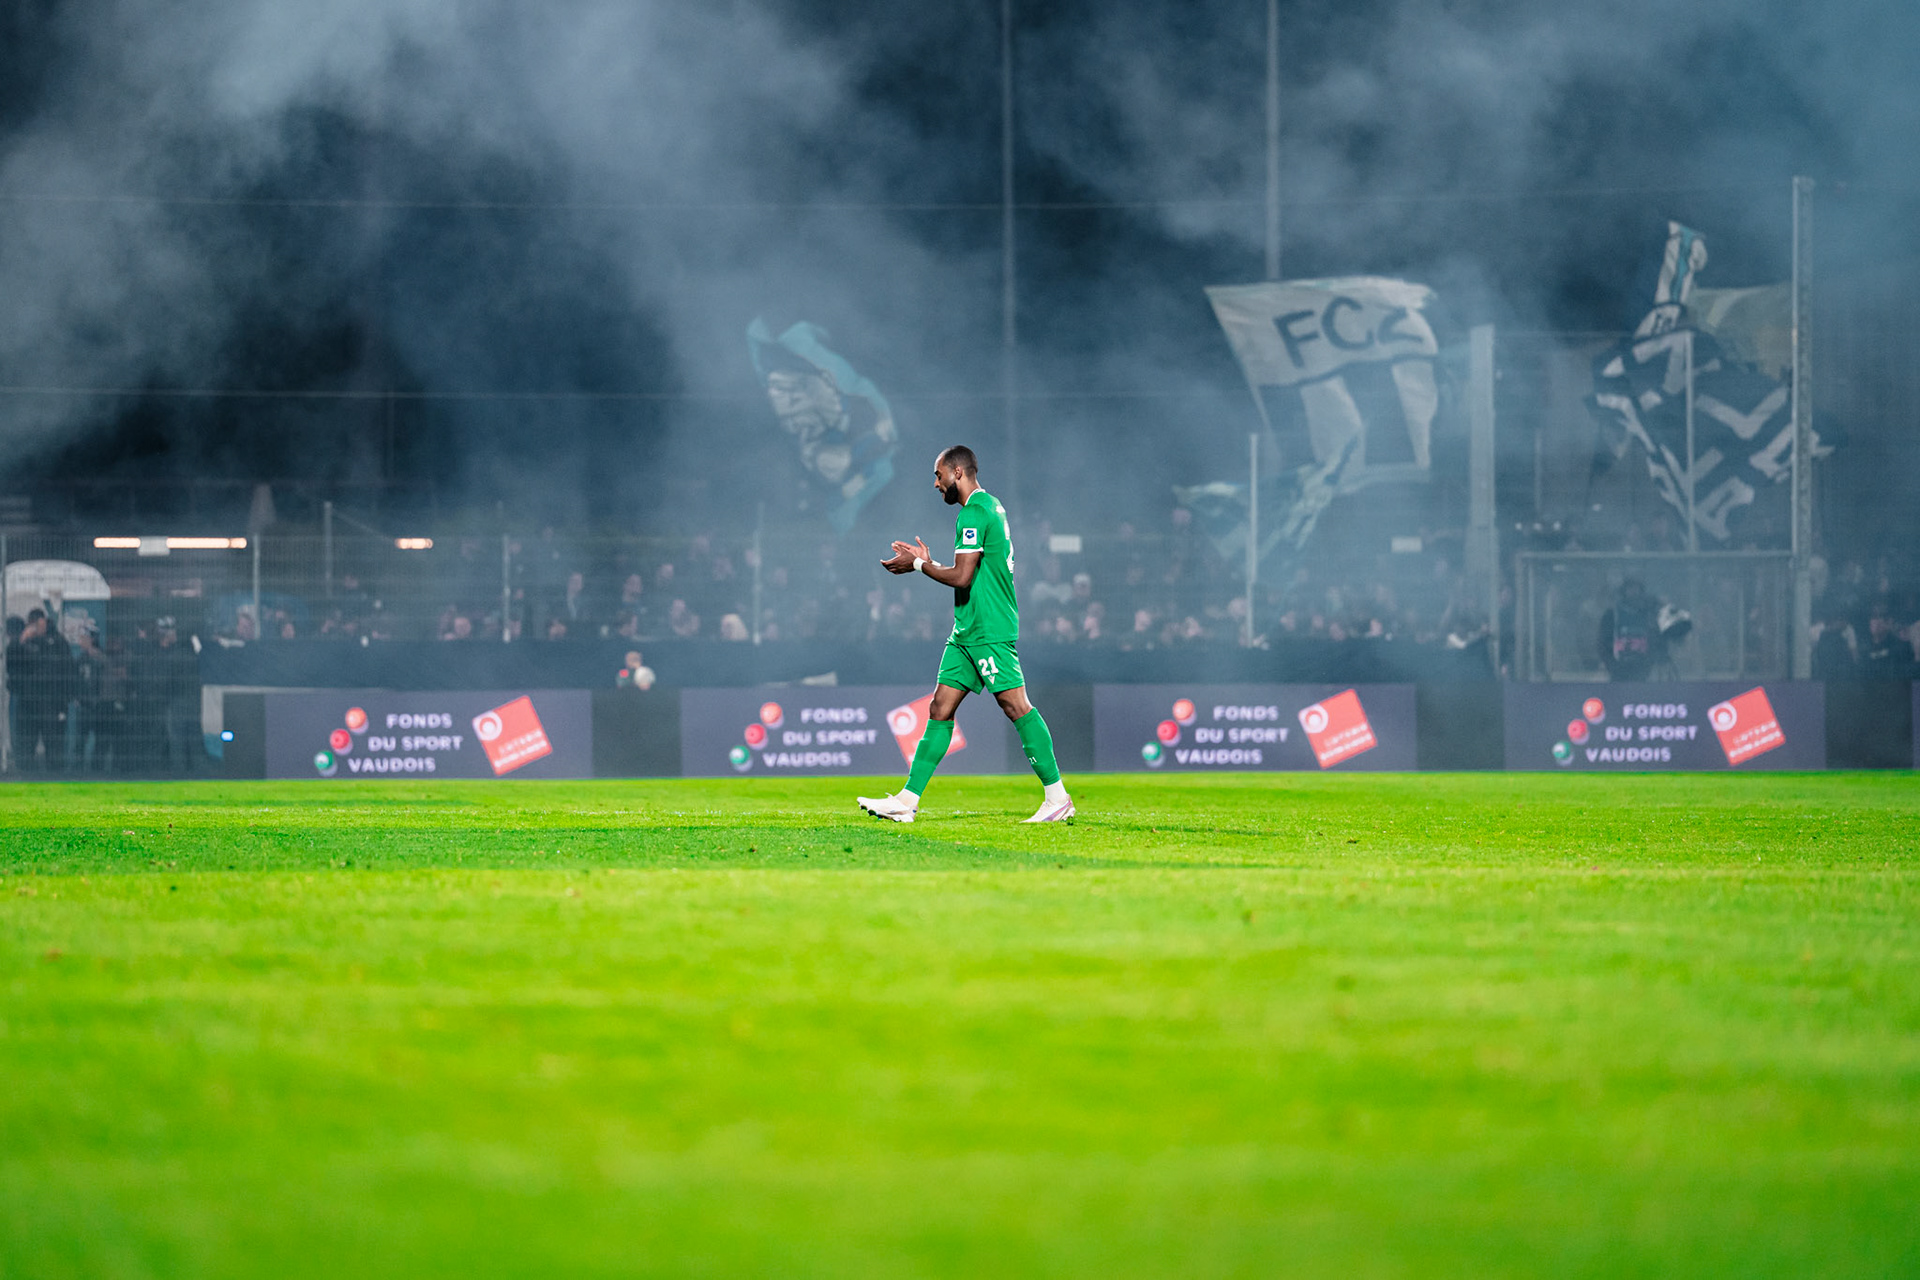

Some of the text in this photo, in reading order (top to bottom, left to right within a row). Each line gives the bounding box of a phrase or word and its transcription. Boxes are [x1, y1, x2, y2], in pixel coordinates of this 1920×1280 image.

[1272, 296, 1425, 370] FCZ
[978, 656, 999, 676] 21
[800, 707, 868, 724] FONDS
[1212, 705, 1279, 721] FONDS
[1622, 703, 1688, 719] FONDS
[386, 712, 453, 729] FONDS
[782, 729, 877, 746] DU SPORT
[1194, 727, 1289, 744] DU SPORT
[1604, 725, 1698, 742] DU SPORT
[367, 735, 463, 752] DU SPORT
[762, 751, 852, 768] VAUDOIS
[1175, 748, 1263, 765] VAUDOIS
[1585, 746, 1671, 763] VAUDOIS
[347, 756, 436, 773] VAUDOIS
